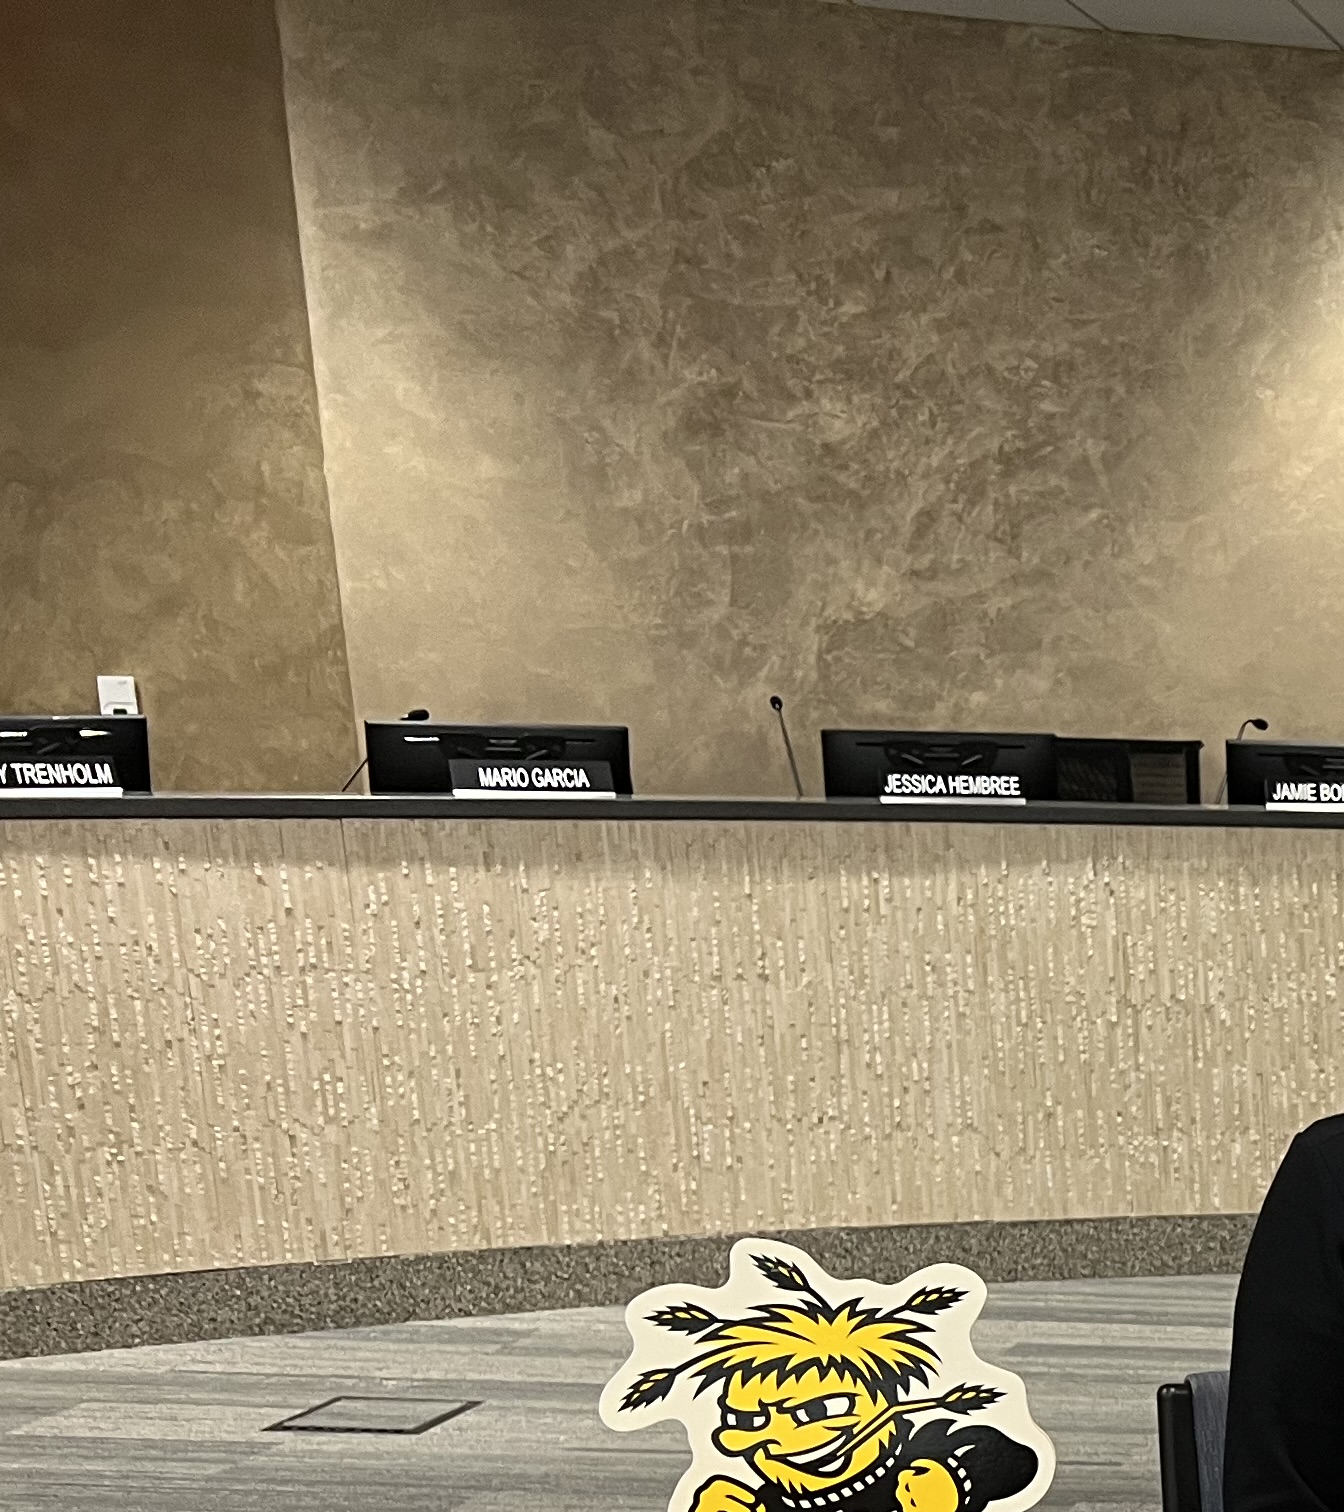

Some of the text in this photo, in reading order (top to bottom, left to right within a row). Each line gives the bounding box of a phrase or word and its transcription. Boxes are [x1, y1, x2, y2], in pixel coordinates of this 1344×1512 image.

[11, 762, 113, 785] TRENHOLM
[478, 766, 590, 789] MARIO GARCIA
[885, 774, 1020, 797] JESSICA HEMBREE
[1273, 781, 1318, 802] JAMIE
